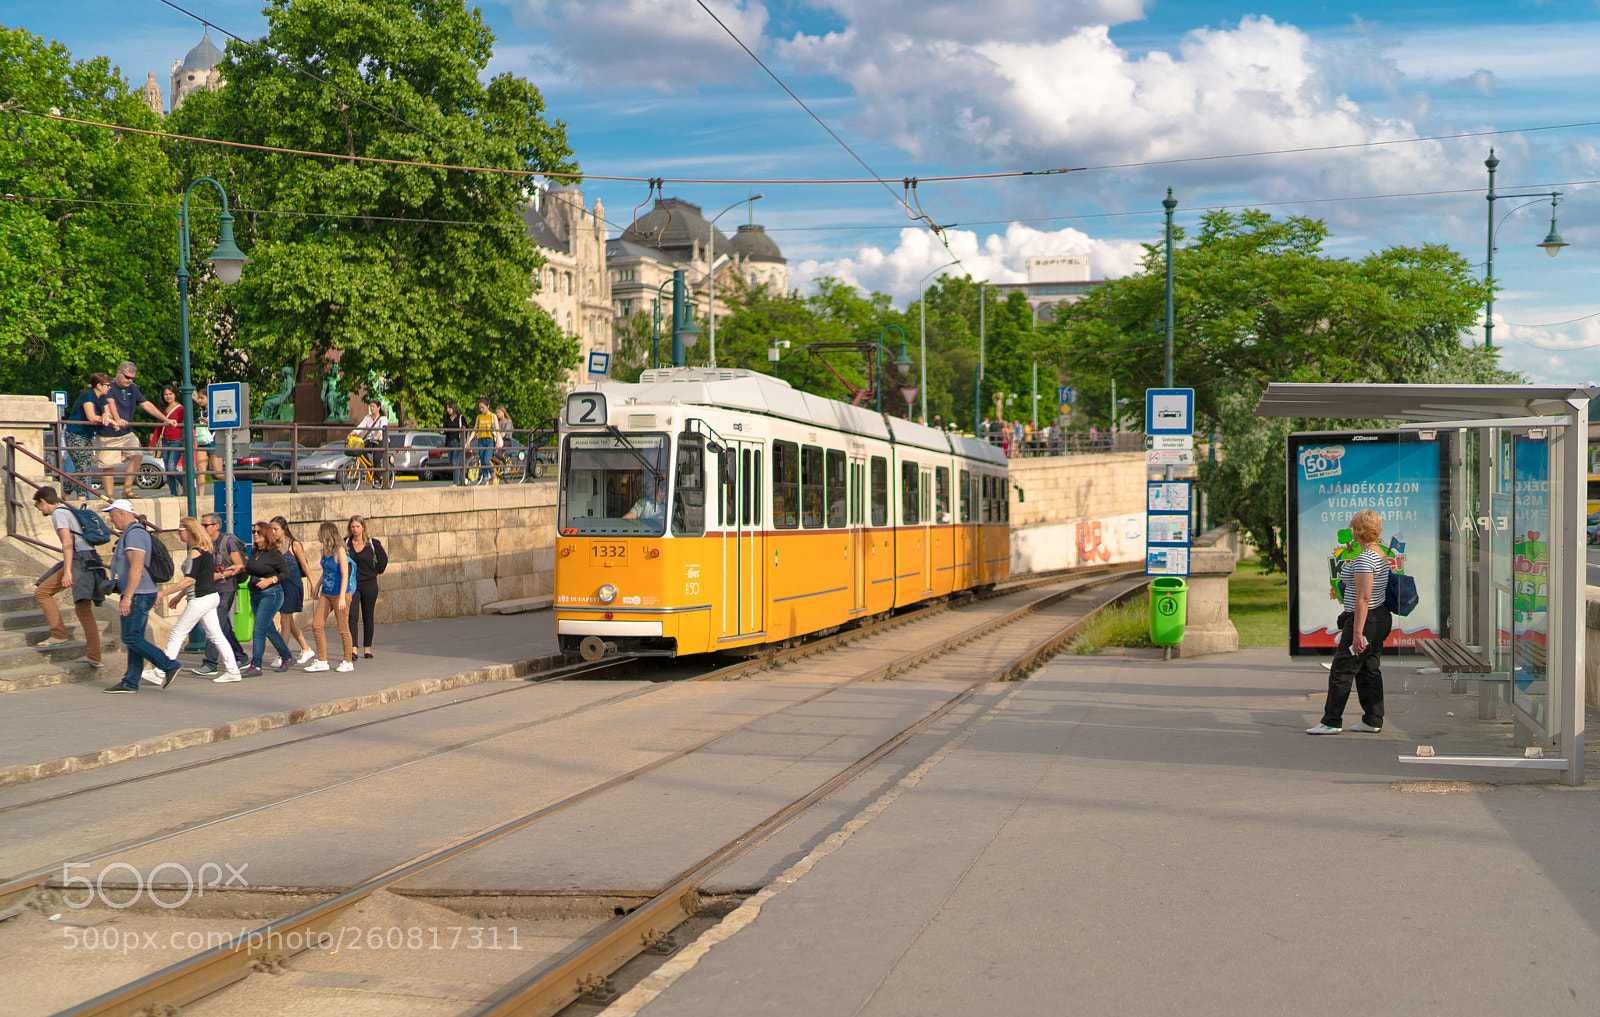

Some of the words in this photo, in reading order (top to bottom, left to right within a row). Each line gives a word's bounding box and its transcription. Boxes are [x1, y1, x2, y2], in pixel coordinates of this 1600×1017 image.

[580, 398, 597, 423] 2
[1307, 457, 1327, 473] 50
[1318, 481, 1419, 494] AJÁNDÉKOZZON
[1328, 495, 1409, 508] VIDÁMSÁGOT
[1321, 510, 1417, 522] GYERAPRA!
[591, 545, 626, 558] 1332
